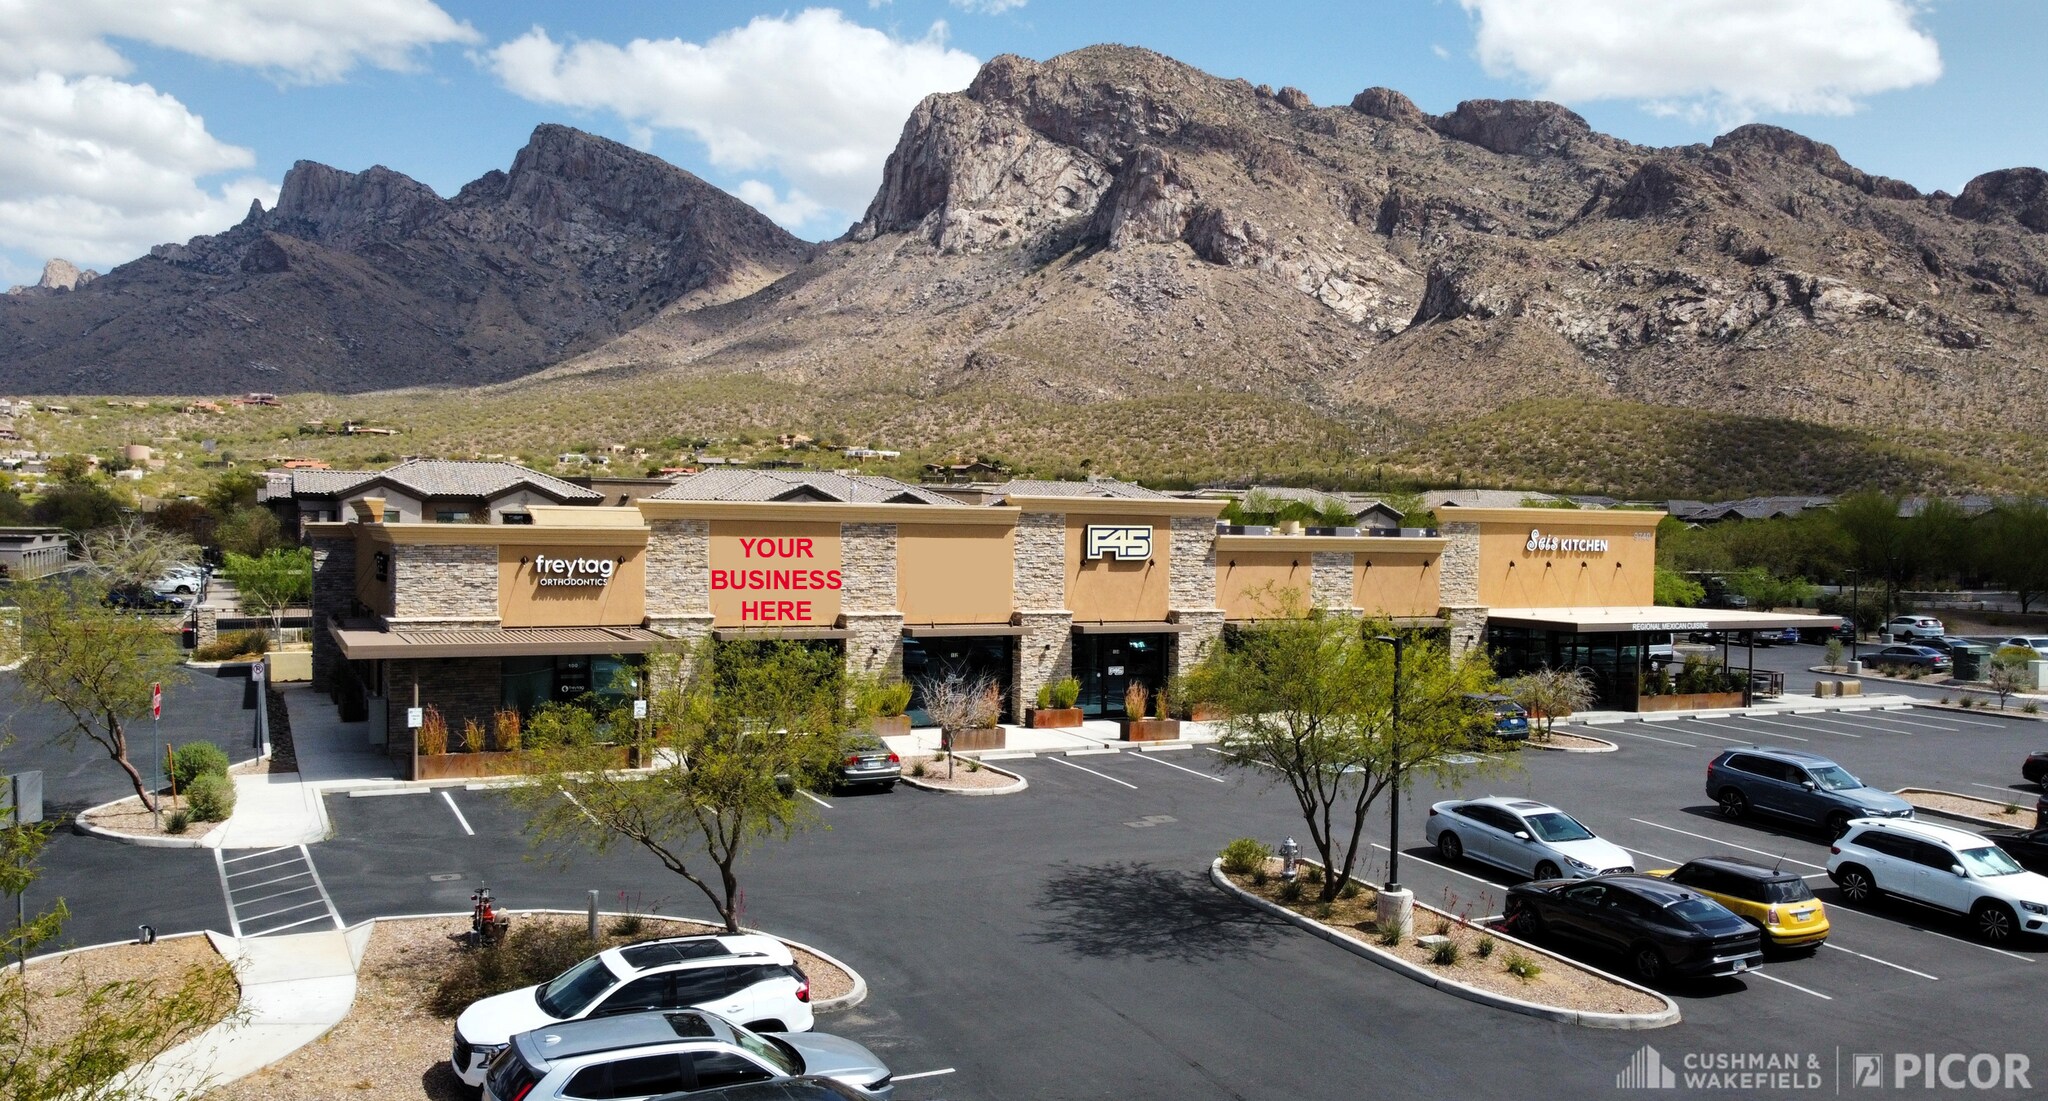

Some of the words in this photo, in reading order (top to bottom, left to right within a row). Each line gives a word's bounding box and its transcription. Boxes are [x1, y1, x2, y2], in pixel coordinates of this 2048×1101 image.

[1088, 526, 1152, 559] F45
[1526, 528, 1560, 551] Seis
[1560, 538, 1608, 551] KITCHEN
[535, 554, 613, 577] freytag
[540, 578, 608, 586] ORTHODONTICS
[1632, 622, 1661, 631] REGIONAL
[1662, 622, 1687, 630] MEXICAN
[1687, 621, 1709, 630] CUISINE
